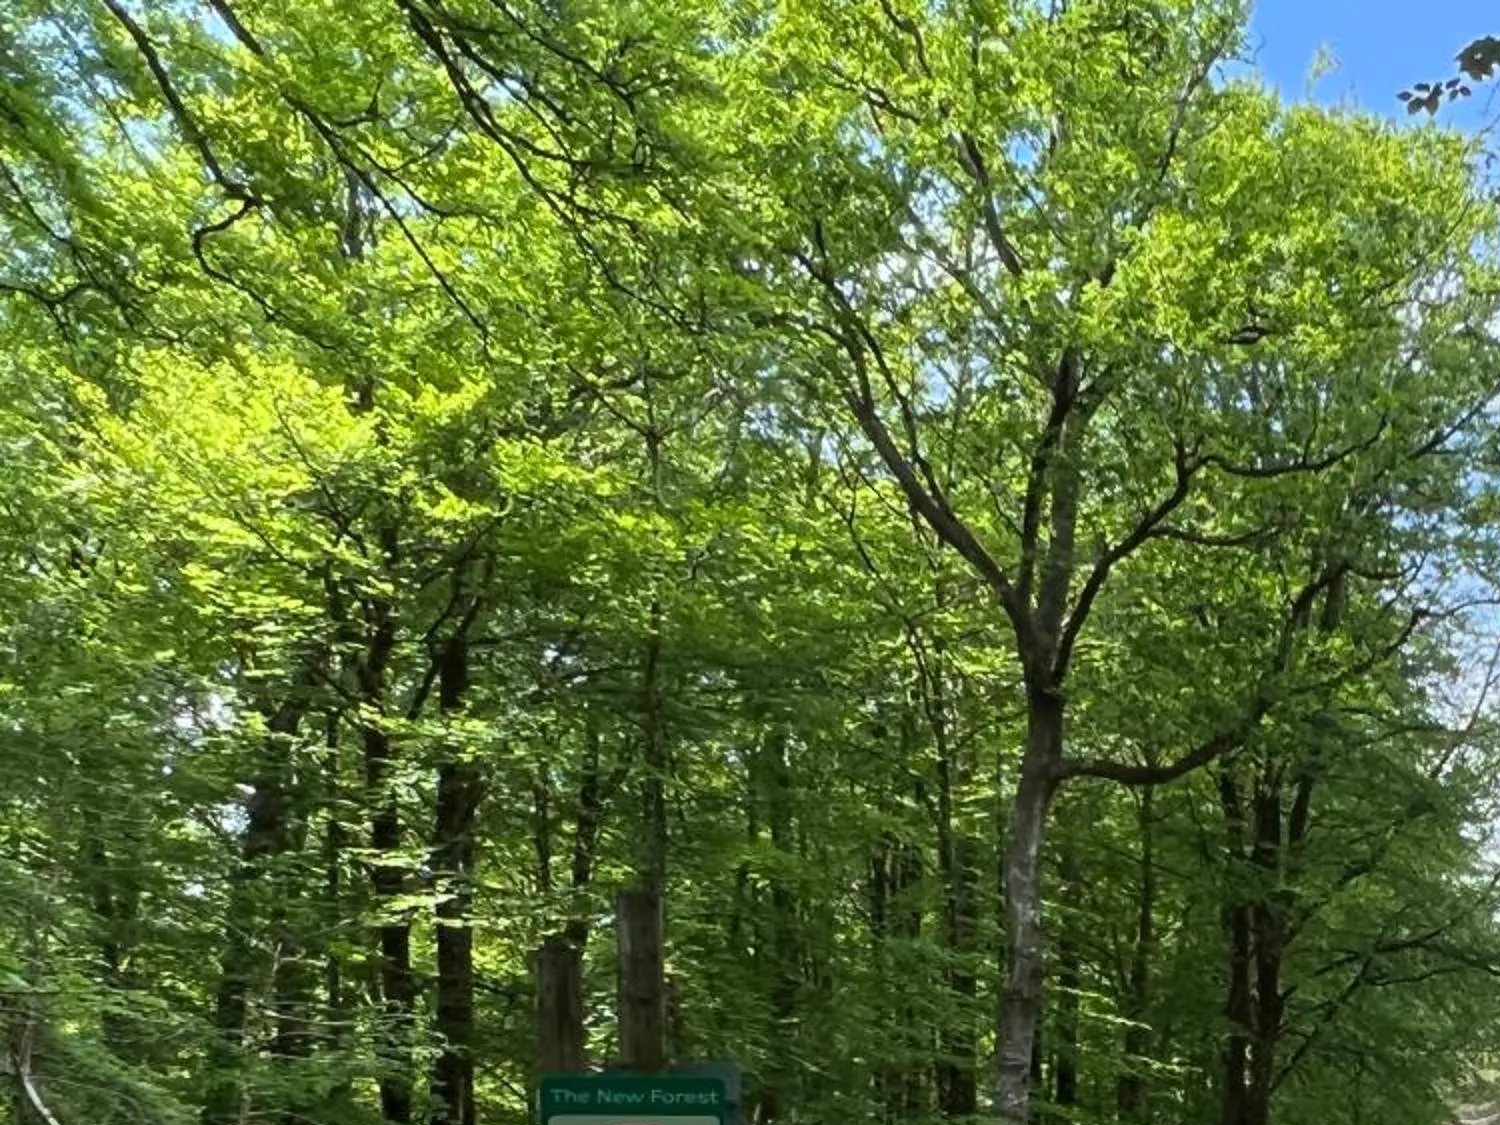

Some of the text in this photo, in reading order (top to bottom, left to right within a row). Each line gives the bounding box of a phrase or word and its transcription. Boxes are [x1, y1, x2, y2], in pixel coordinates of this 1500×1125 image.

[550, 1088, 720, 1105] The New Forest
